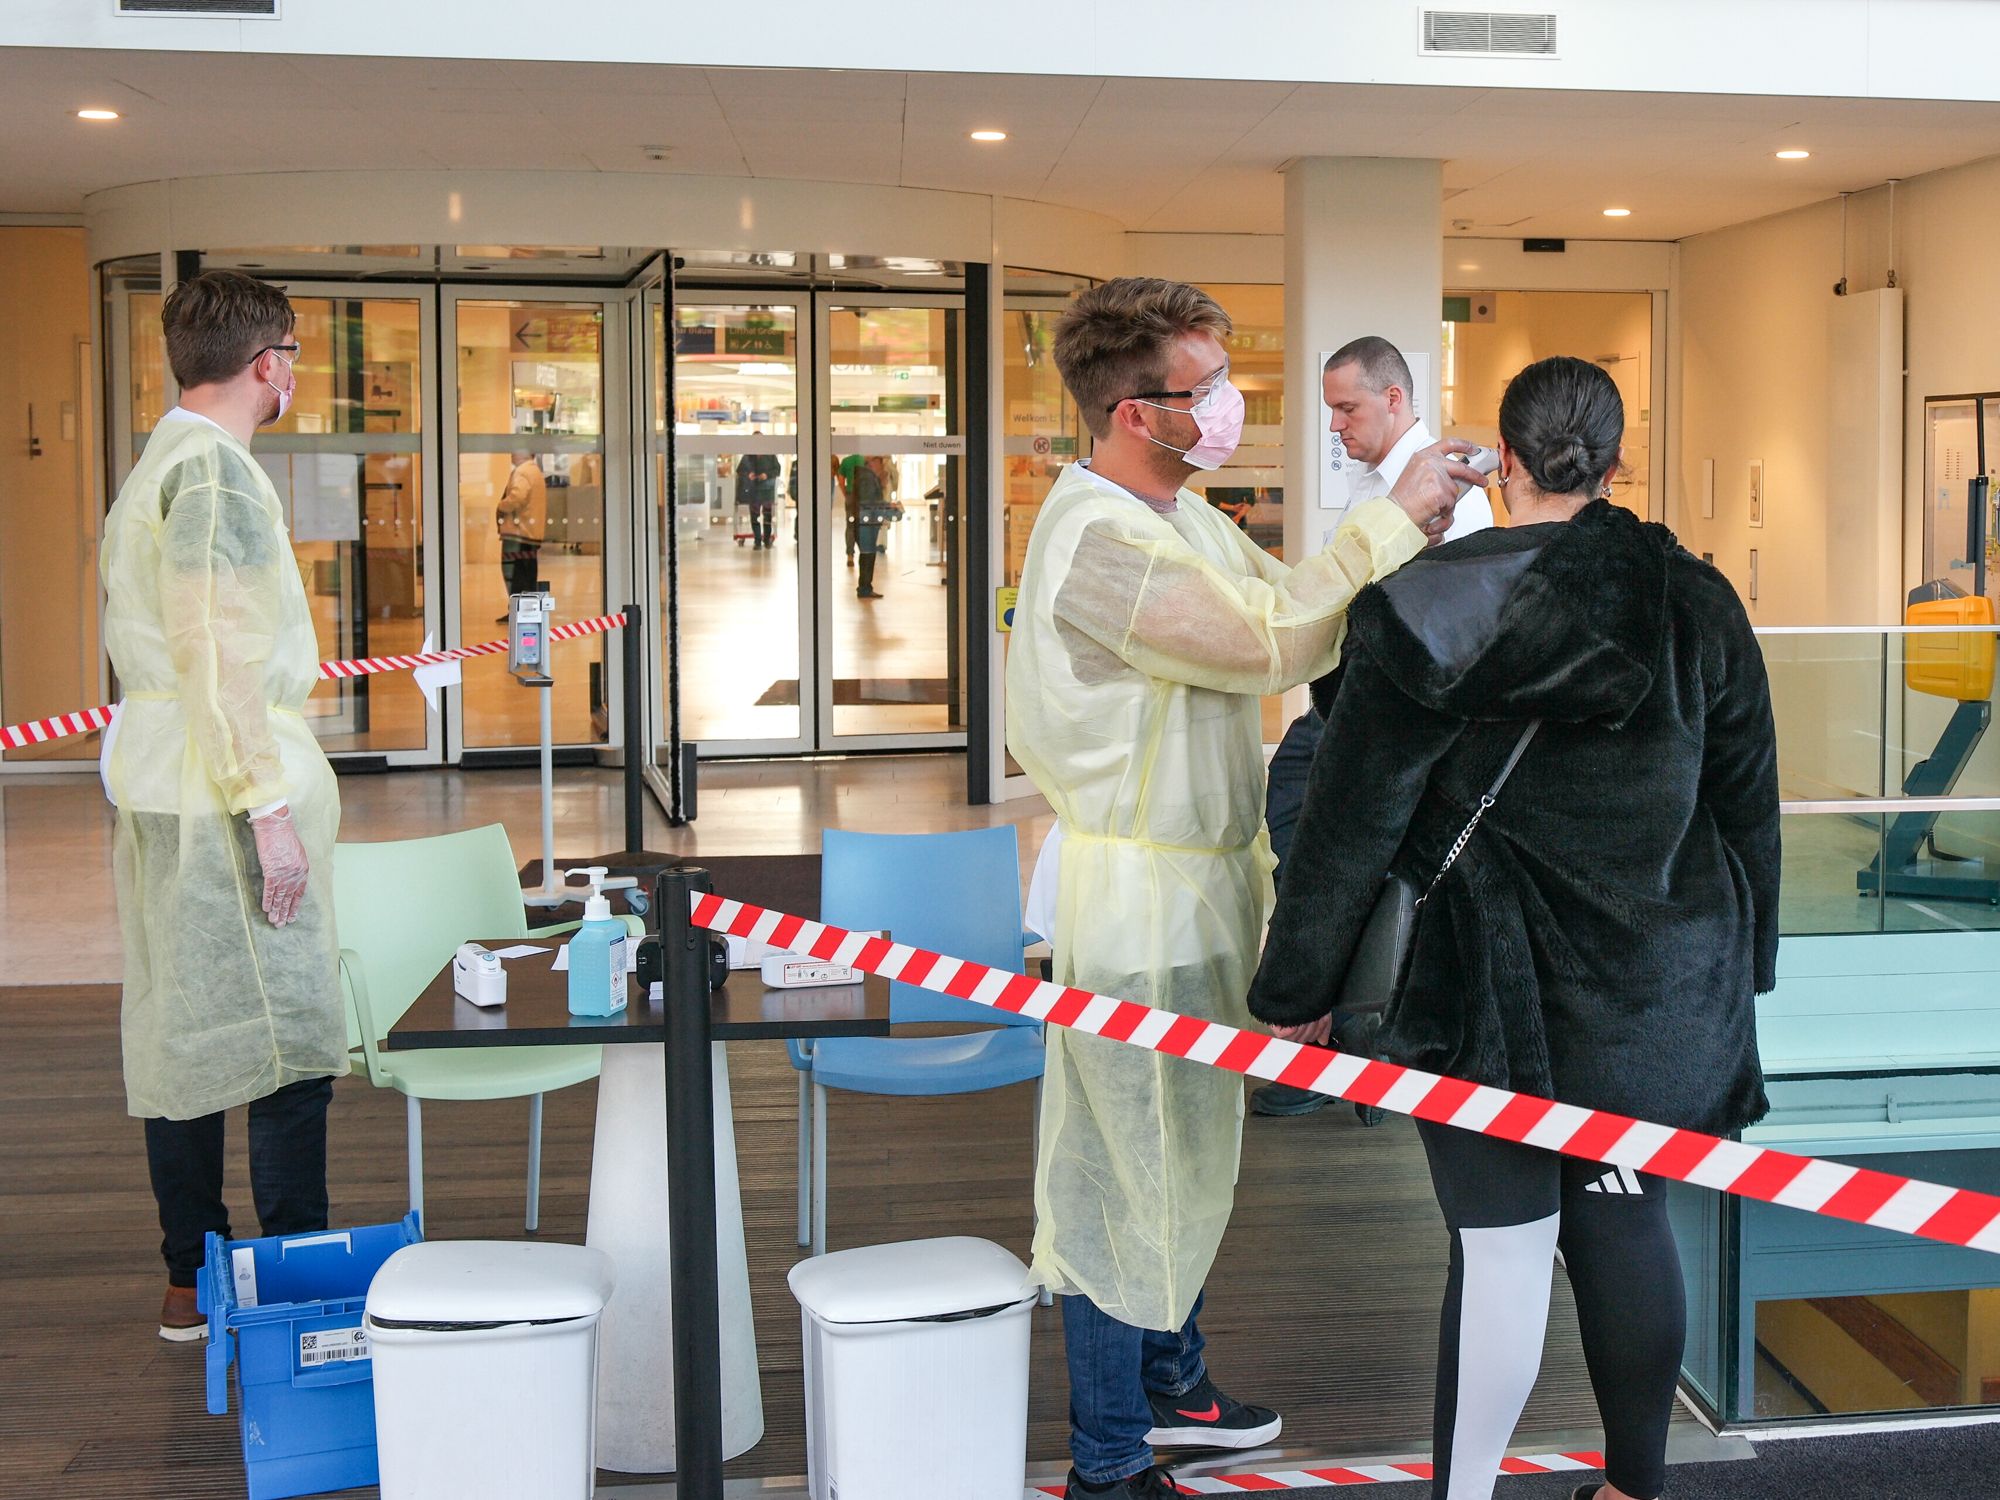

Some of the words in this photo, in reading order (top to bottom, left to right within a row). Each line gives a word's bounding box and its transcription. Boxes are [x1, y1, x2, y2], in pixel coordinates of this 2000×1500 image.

[1013, 413, 1048, 422] Welkom
[923, 441, 937, 449] Niet
[939, 441, 961, 449] duwen
